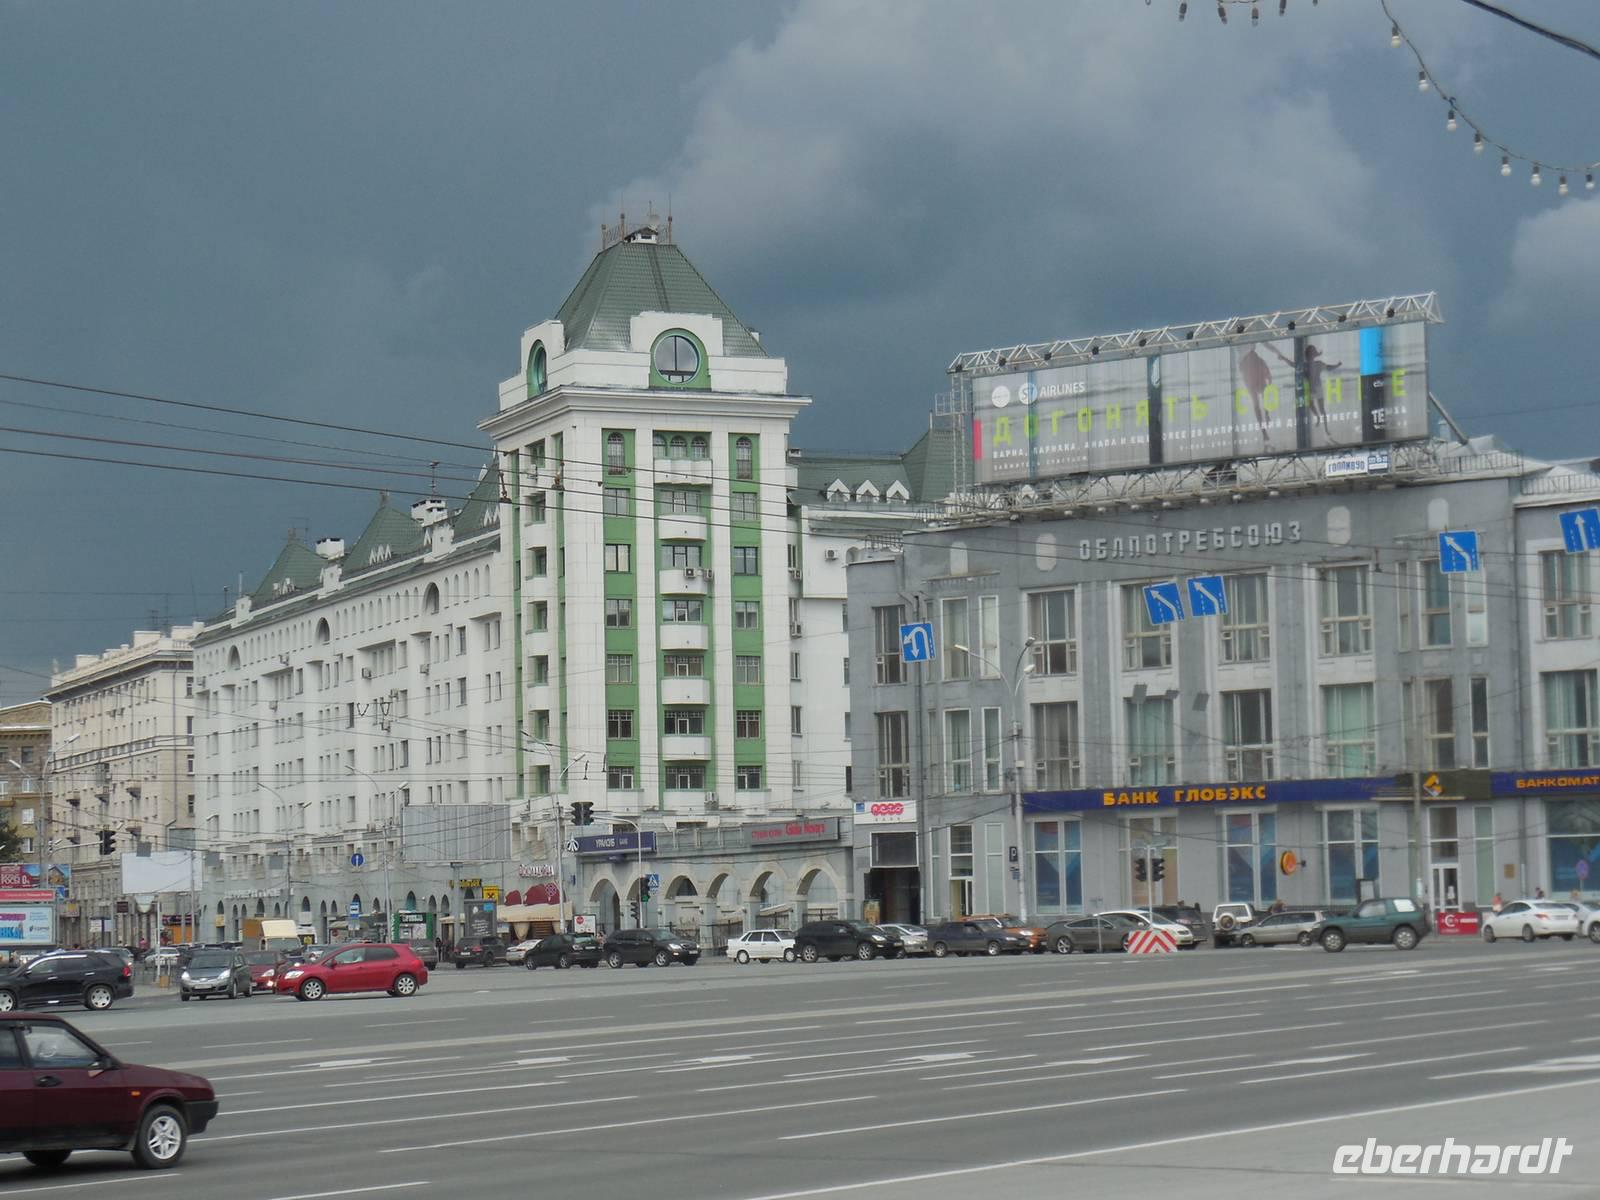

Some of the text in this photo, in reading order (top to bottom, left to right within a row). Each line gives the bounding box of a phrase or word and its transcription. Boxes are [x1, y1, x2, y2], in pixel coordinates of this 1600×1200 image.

[1040, 381, 1085, 399] AIRLINES
[993, 391, 1208, 447] ДОГОНЯТЬ
[1080, 520, 1301, 560] ОБЛПОТРЕБСОЮЗ
[1515, 776, 1600, 789] БАНКОМАТ
[1103, 785, 1267, 806] БАНК ГЛОБЭКС
